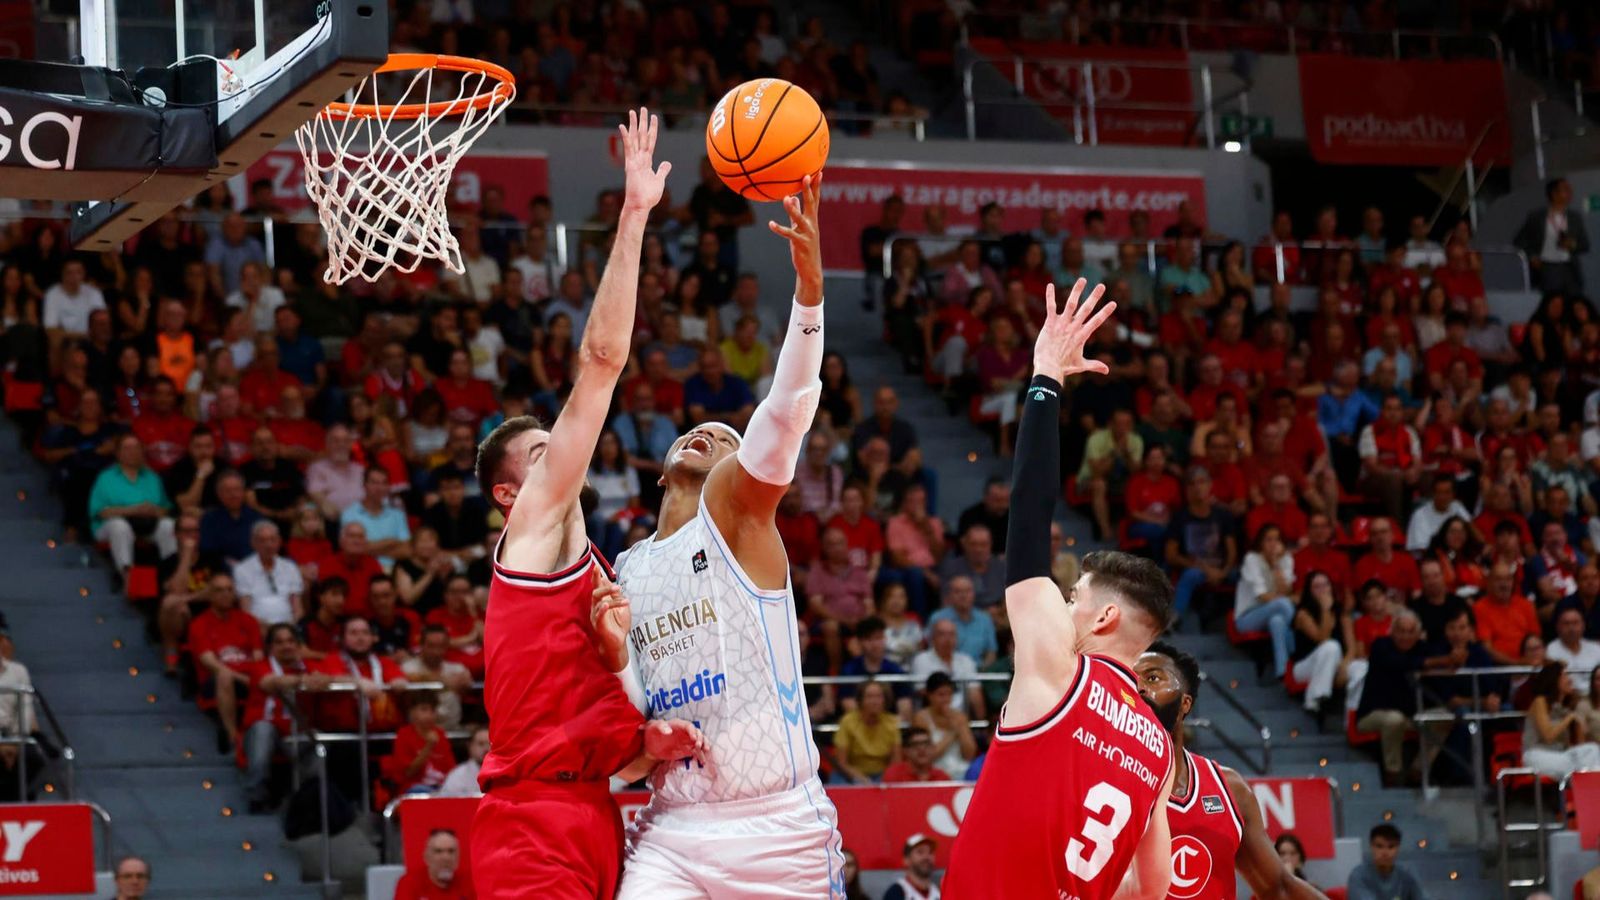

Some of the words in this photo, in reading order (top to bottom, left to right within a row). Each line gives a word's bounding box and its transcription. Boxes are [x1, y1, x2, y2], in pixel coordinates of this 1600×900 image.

[820, 178, 1189, 214] wwwzaragozadeporte.com
[631, 598, 718, 654] VALENCIA
[649, 634, 695, 662] BASKET
[1072, 726, 1097, 750] AIR
[1087, 680, 1165, 759] BLUMBERGS
[0, 820, 47, 862] Y
[1064, 780, 1133, 883] 3
